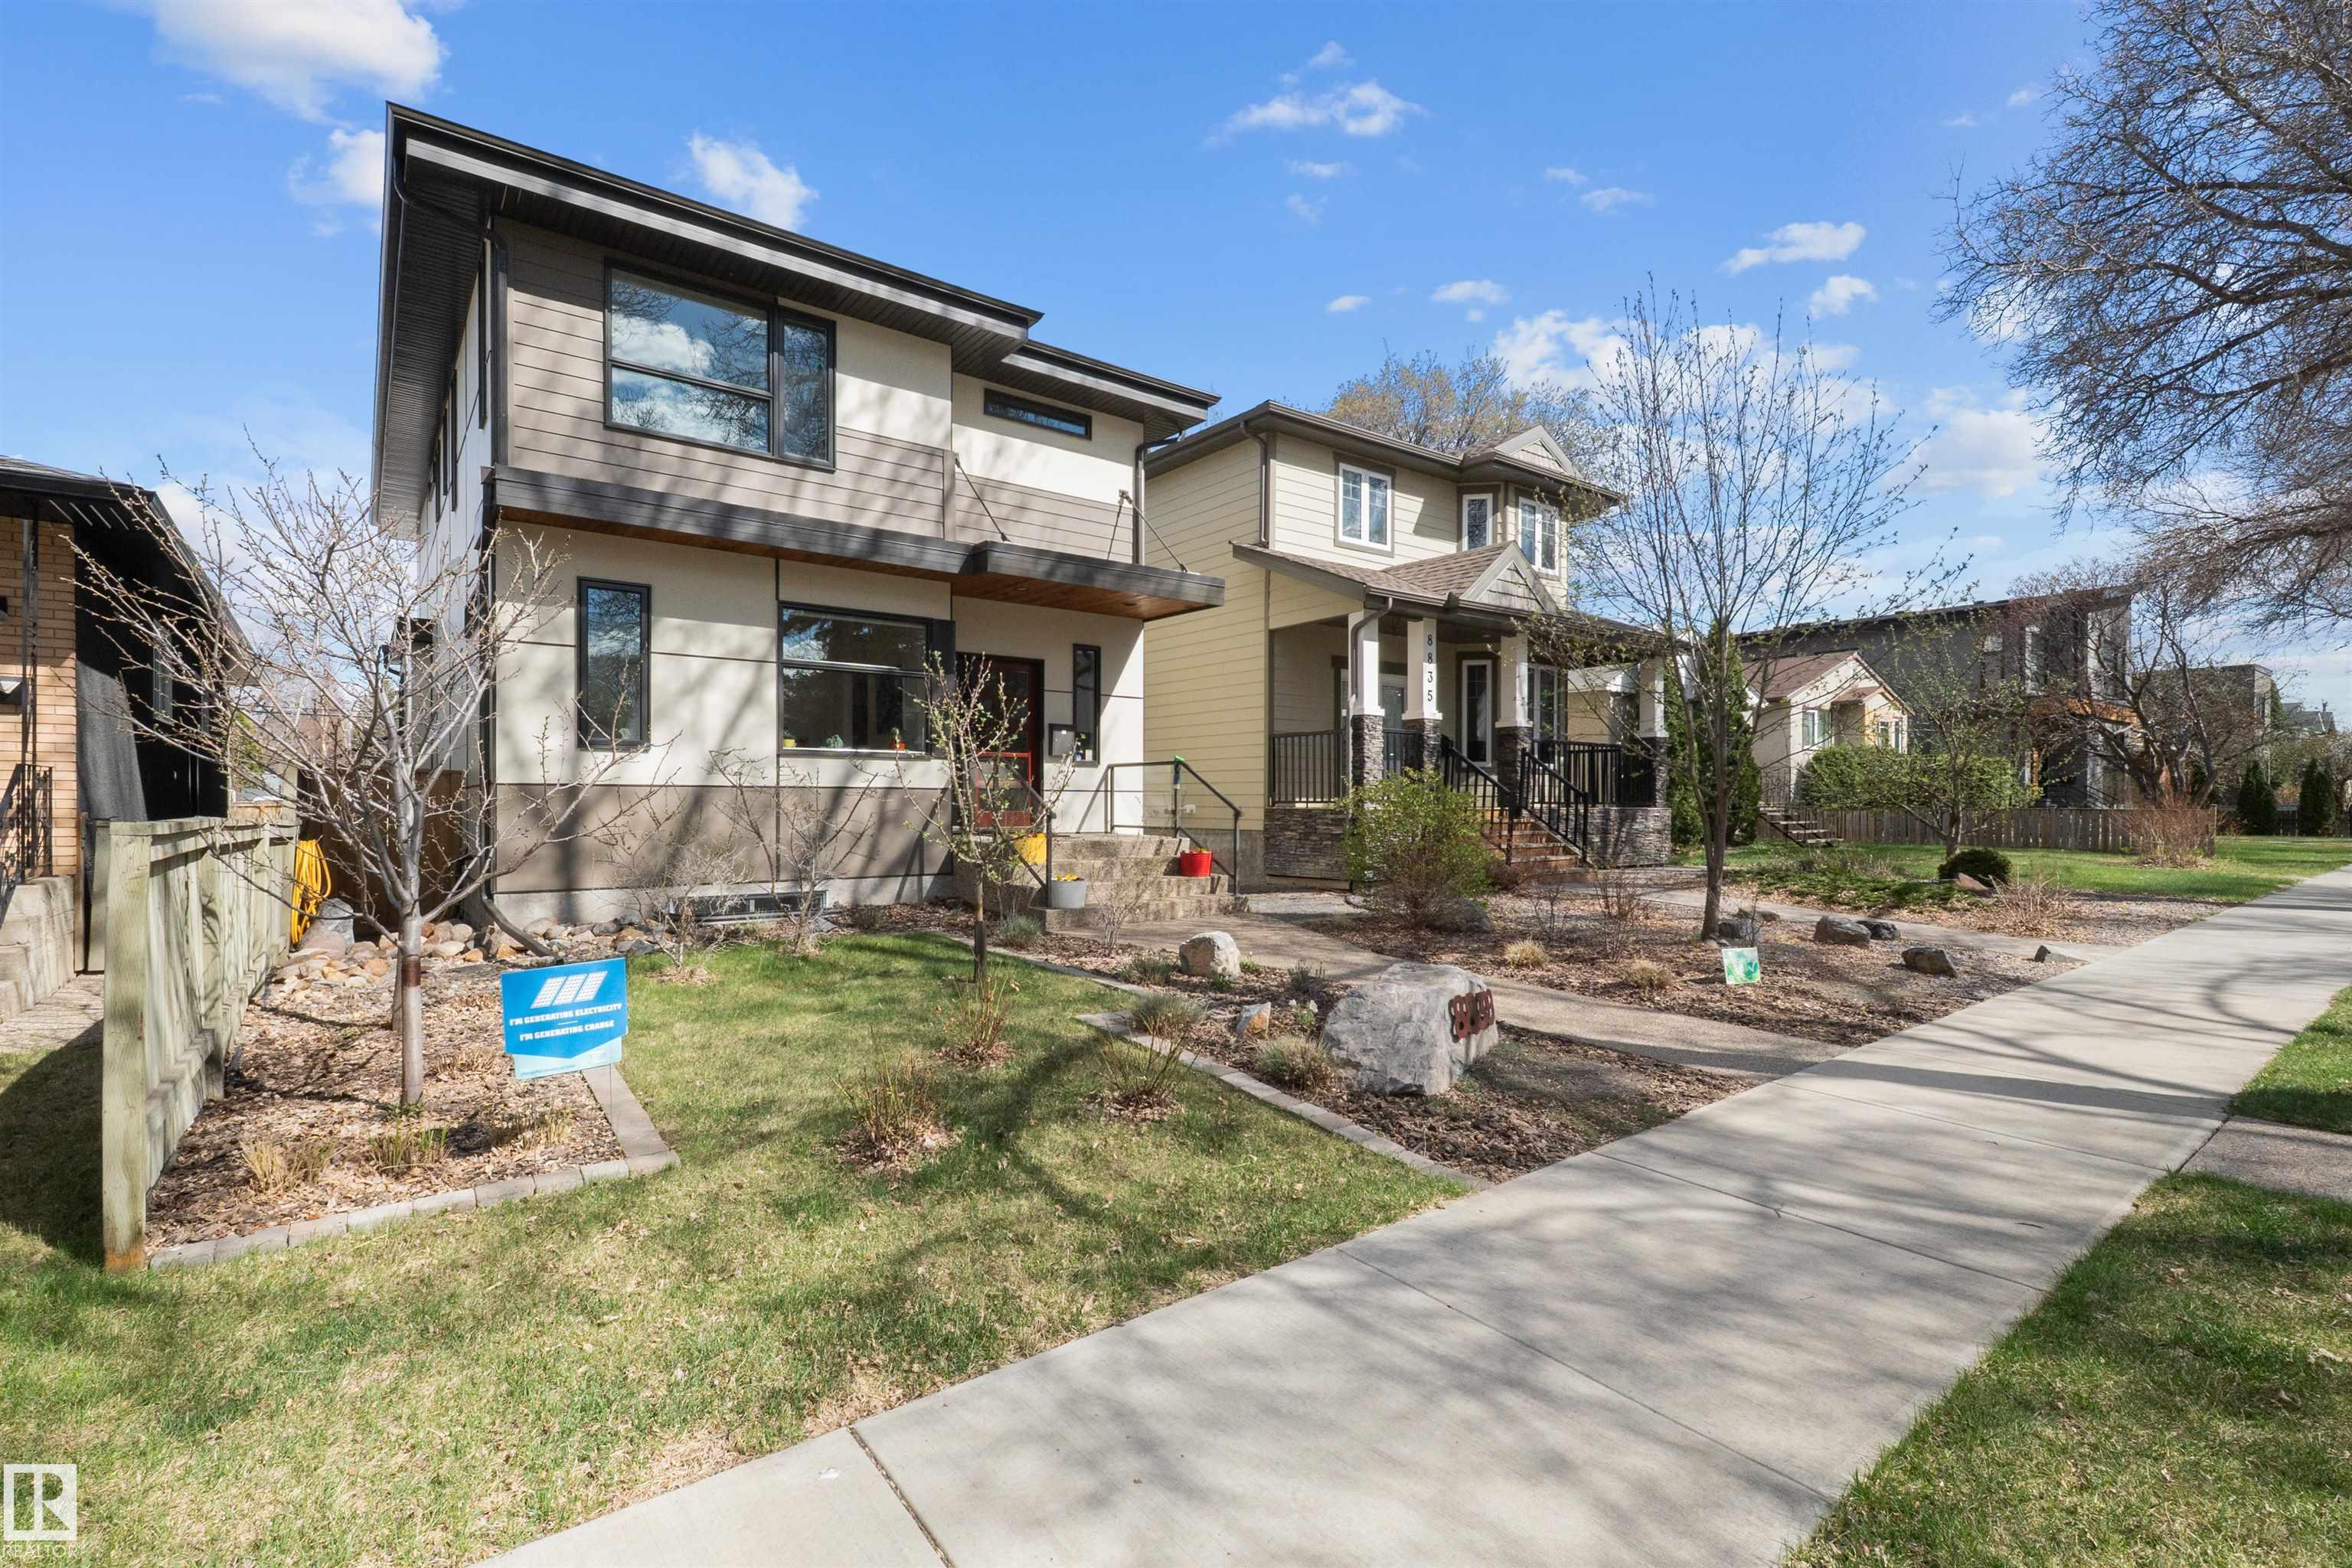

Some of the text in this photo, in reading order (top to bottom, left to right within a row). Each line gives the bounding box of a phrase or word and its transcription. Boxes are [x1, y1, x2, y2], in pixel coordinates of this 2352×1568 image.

[524, 1011, 573, 1023] GENERATING
[576, 1003, 622, 1015] ELECTRICITY
[534, 1026, 583, 1038] GENERATING
[585, 1020, 614, 1031] CHANGE
